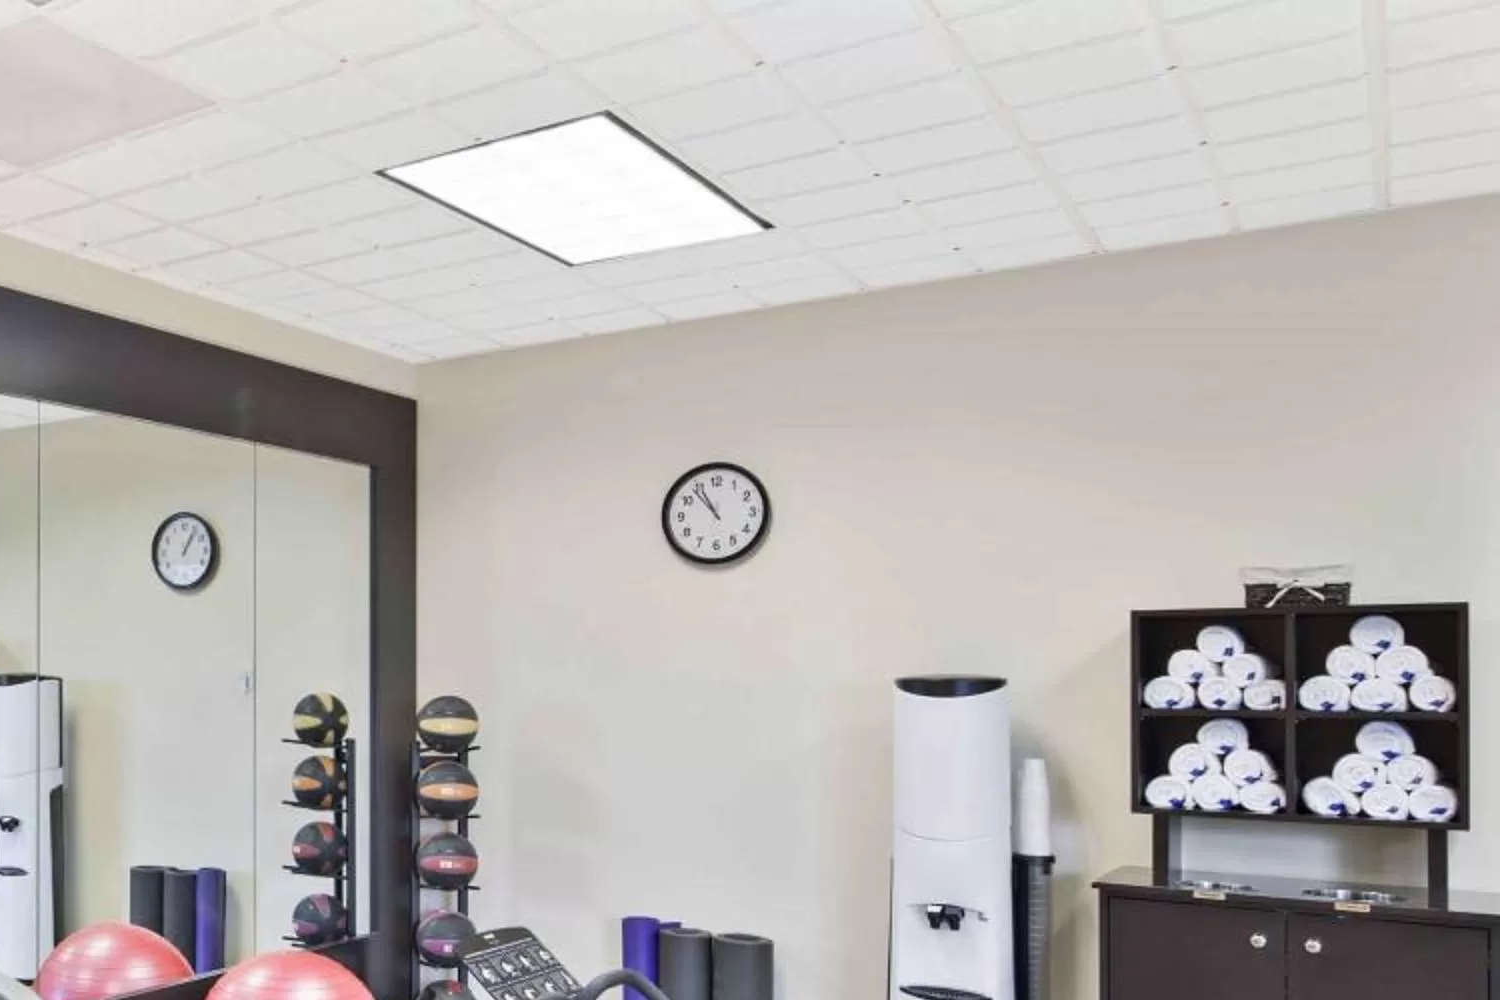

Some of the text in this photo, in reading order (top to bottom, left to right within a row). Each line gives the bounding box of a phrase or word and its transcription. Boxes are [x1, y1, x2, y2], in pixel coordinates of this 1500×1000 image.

[710, 475, 724, 488] 12
[683, 495, 695, 507] 10
[743, 489, 752, 502] 2
[677, 511, 686, 523] 9
[748, 505, 757, 518] 3
[695, 535, 705, 549] 7
